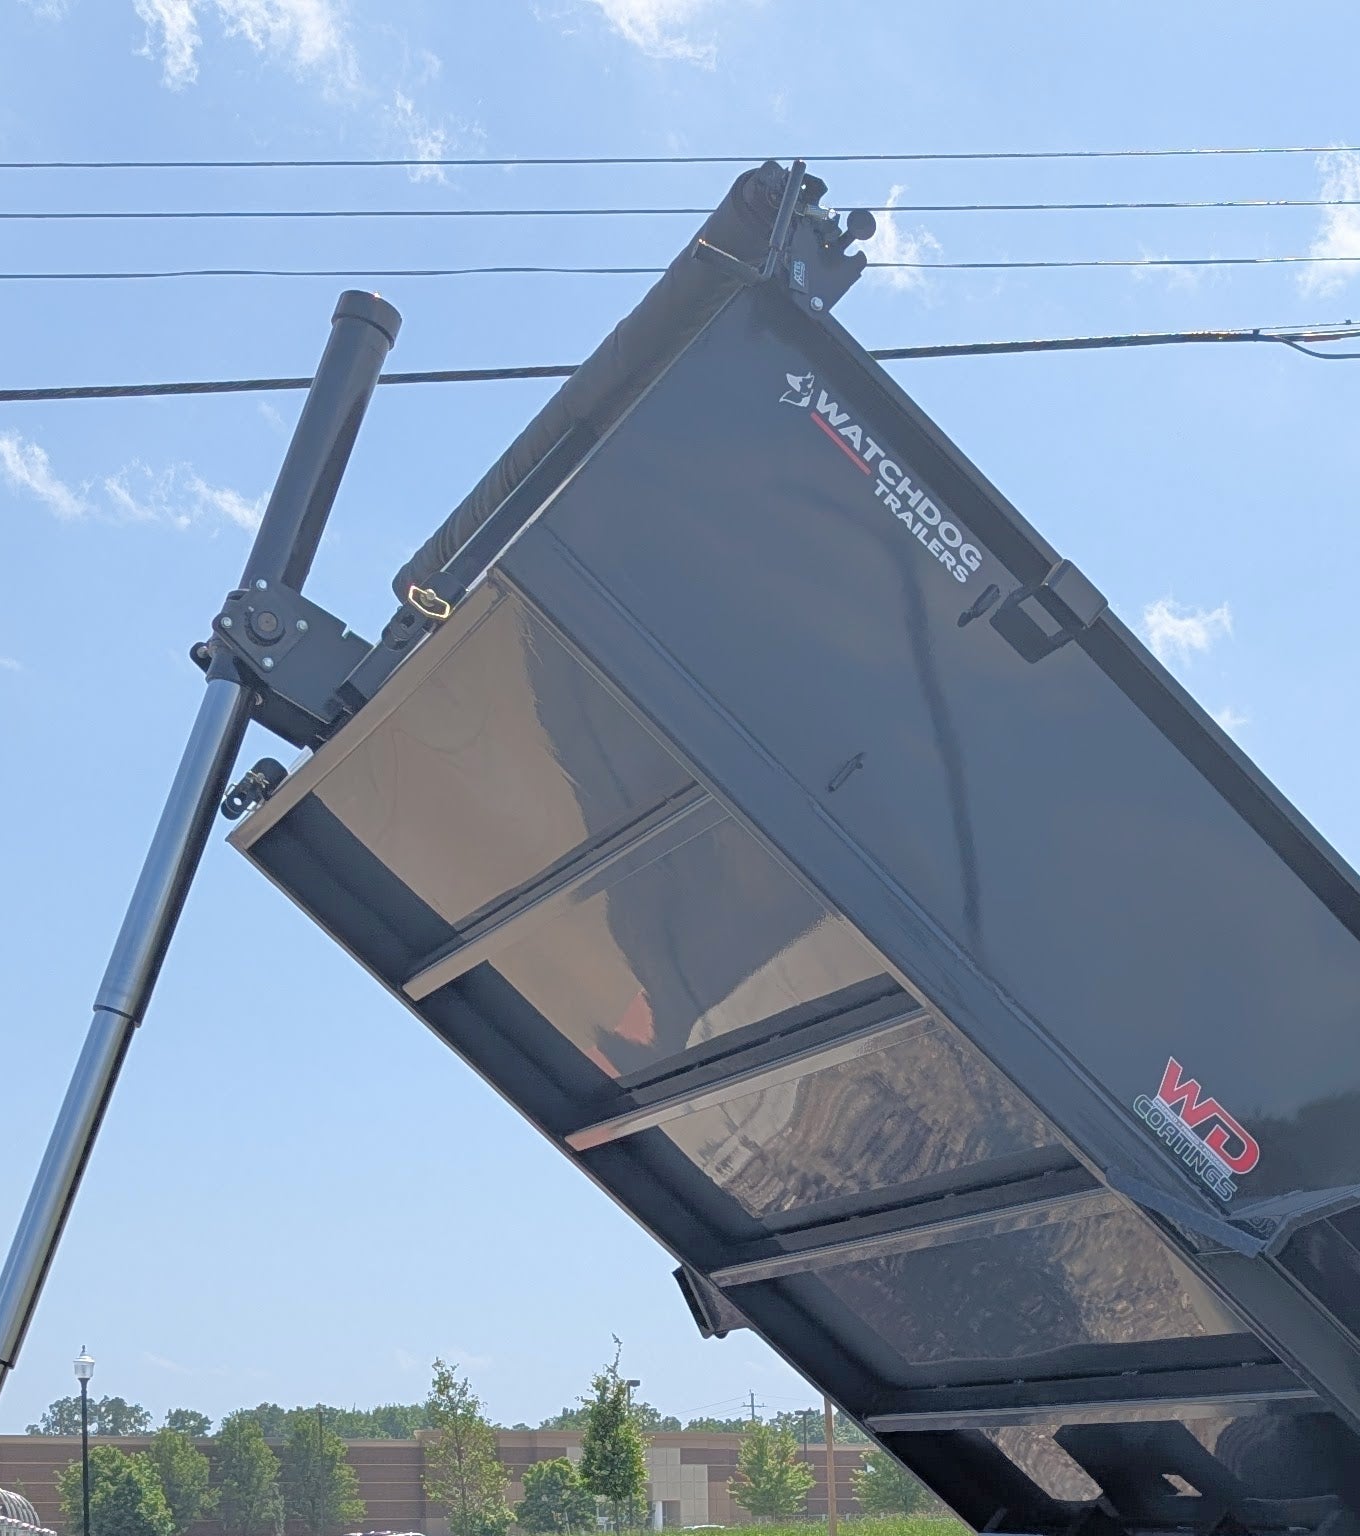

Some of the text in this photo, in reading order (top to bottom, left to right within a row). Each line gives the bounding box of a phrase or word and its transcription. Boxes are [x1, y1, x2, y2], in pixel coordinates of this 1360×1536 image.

[815, 389, 983, 572] WATCHDOG
[874, 479, 969, 584] TRAILERS
[1133, 1094, 1238, 1201] COATINGS
[1157, 1056, 1260, 1175] WD
